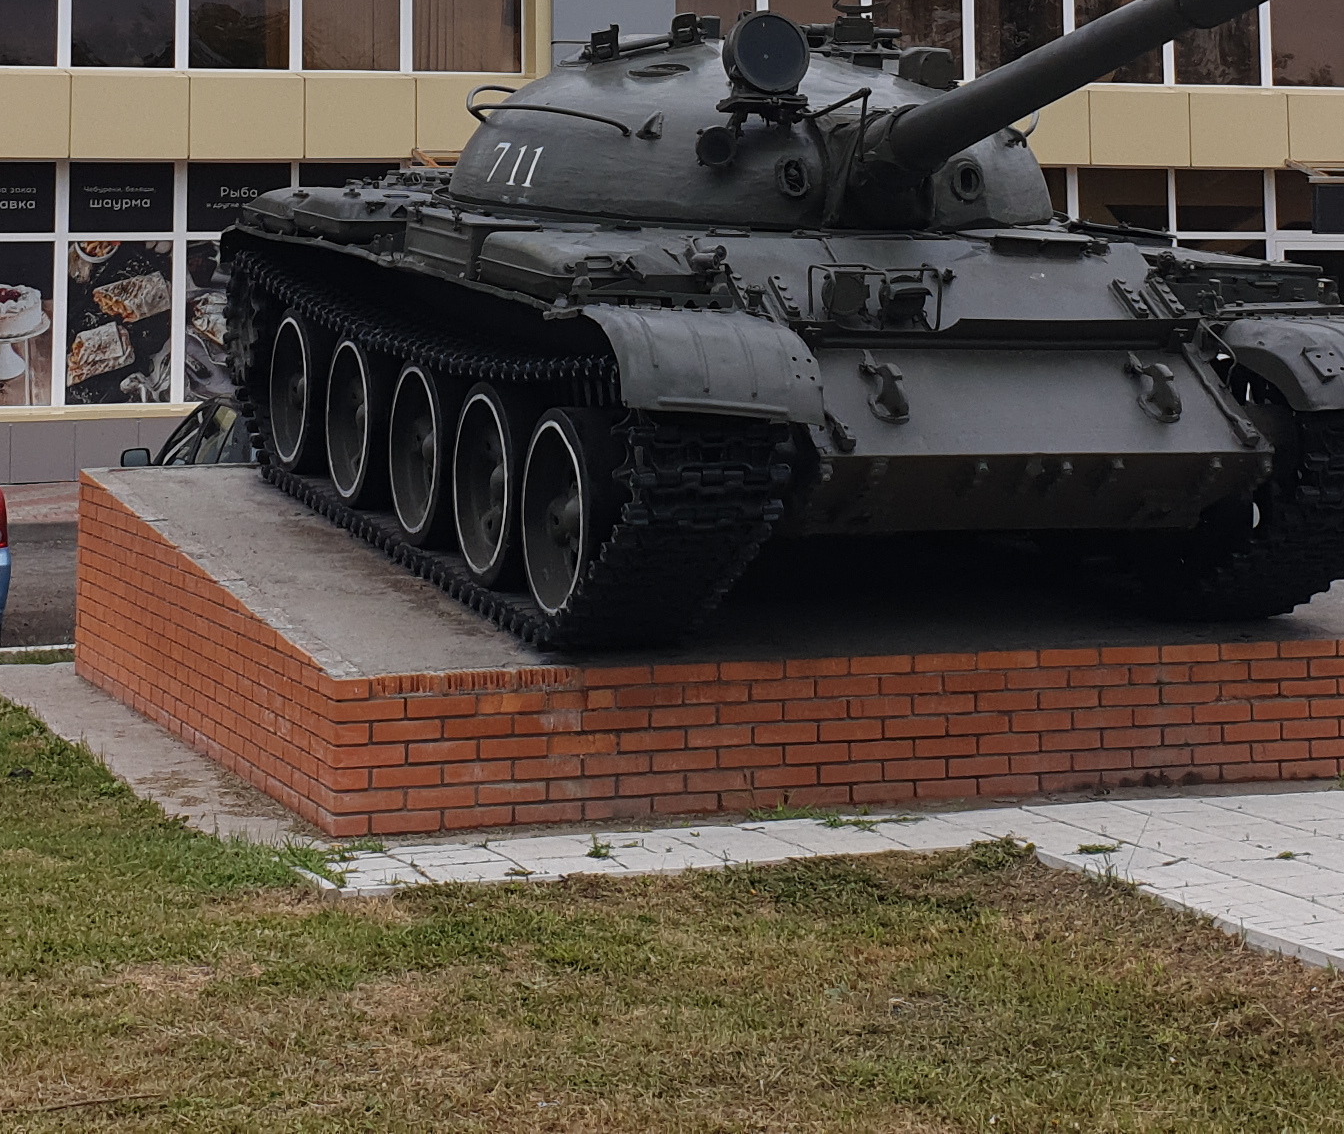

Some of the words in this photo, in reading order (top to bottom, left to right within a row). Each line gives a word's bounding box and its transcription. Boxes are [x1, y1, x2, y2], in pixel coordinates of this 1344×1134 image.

[487, 142, 544, 188] 711
[220, 186, 258, 198] Рыба
[89, 199, 151, 210] шаурма
